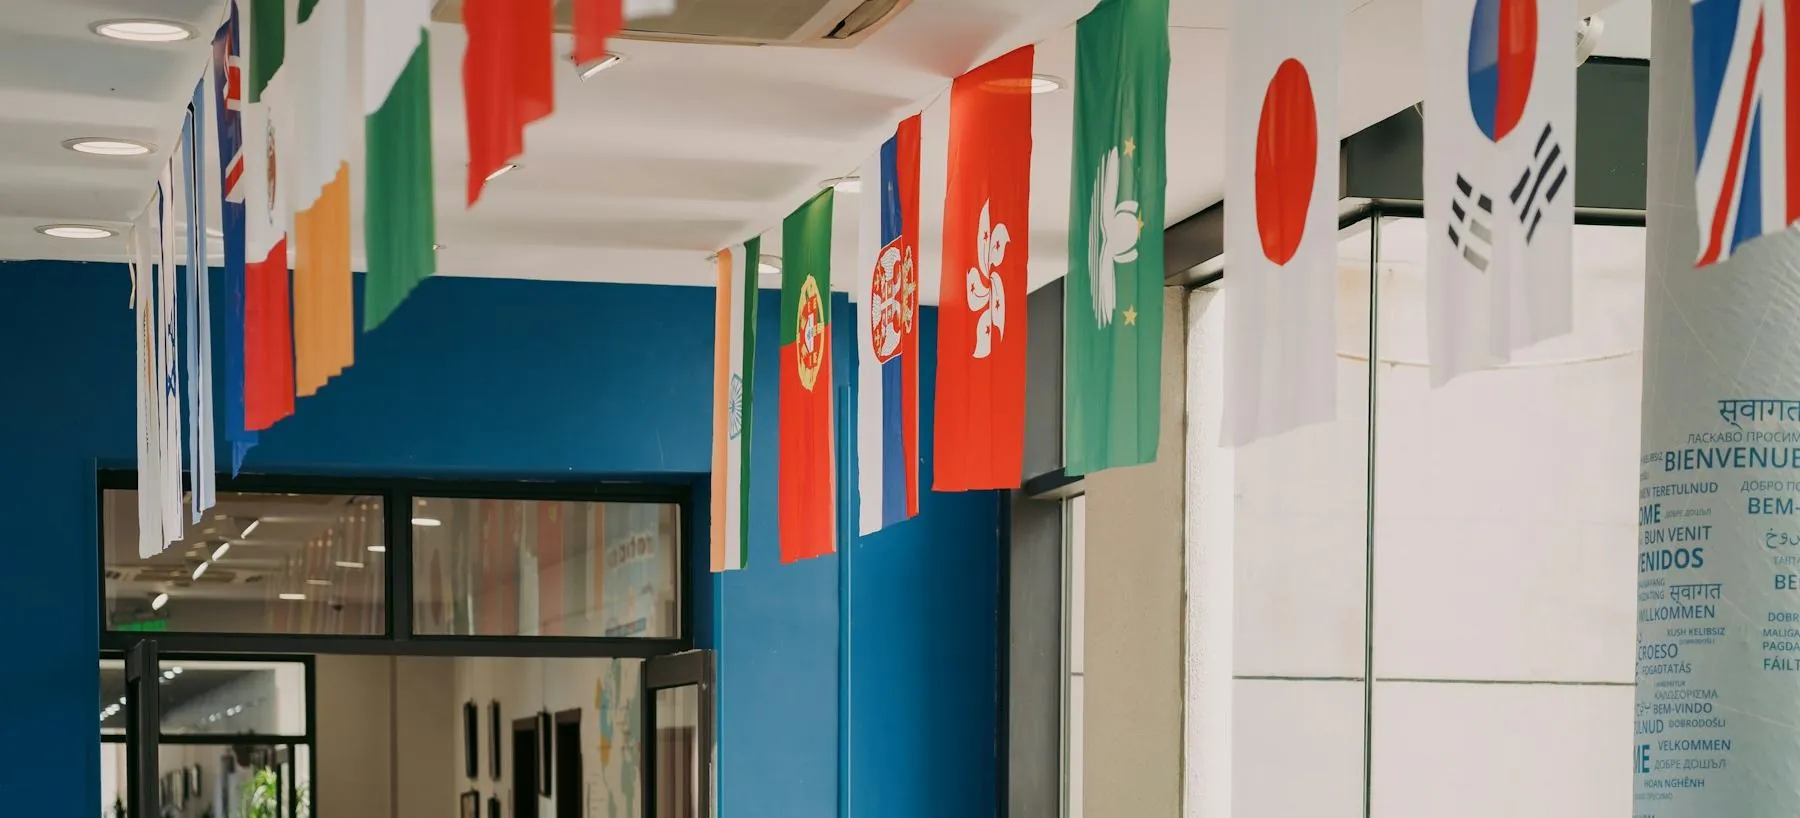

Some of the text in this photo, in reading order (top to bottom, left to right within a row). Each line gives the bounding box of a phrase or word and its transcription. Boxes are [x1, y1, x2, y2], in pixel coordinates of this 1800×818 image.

[1688, 432, 1742, 444] ЛАСКАВО
[1664, 447, 1800, 472] BIENVENUE
[1652, 482, 1718, 498] TERETULNUD
[1740, 480, 1784, 493] ДОБРО
[1644, 525, 1713, 545] BUN VENIT
[1639, 547, 1704, 573] ENIDOS
[1774, 574, 1800, 589] BE
[1688, 627, 1726, 637] KELIBSIZ
[1653, 702, 1713, 715] BEM-VINDO
[1668, 718, 1726, 729] DOBRODOŠLI
[1658, 739, 1731, 751] VELKOMMEN
[1654, 758, 1727, 770] ДОБРЕ ДОШЪЛ
[1664, 776, 1705, 788] NGHÊNH
